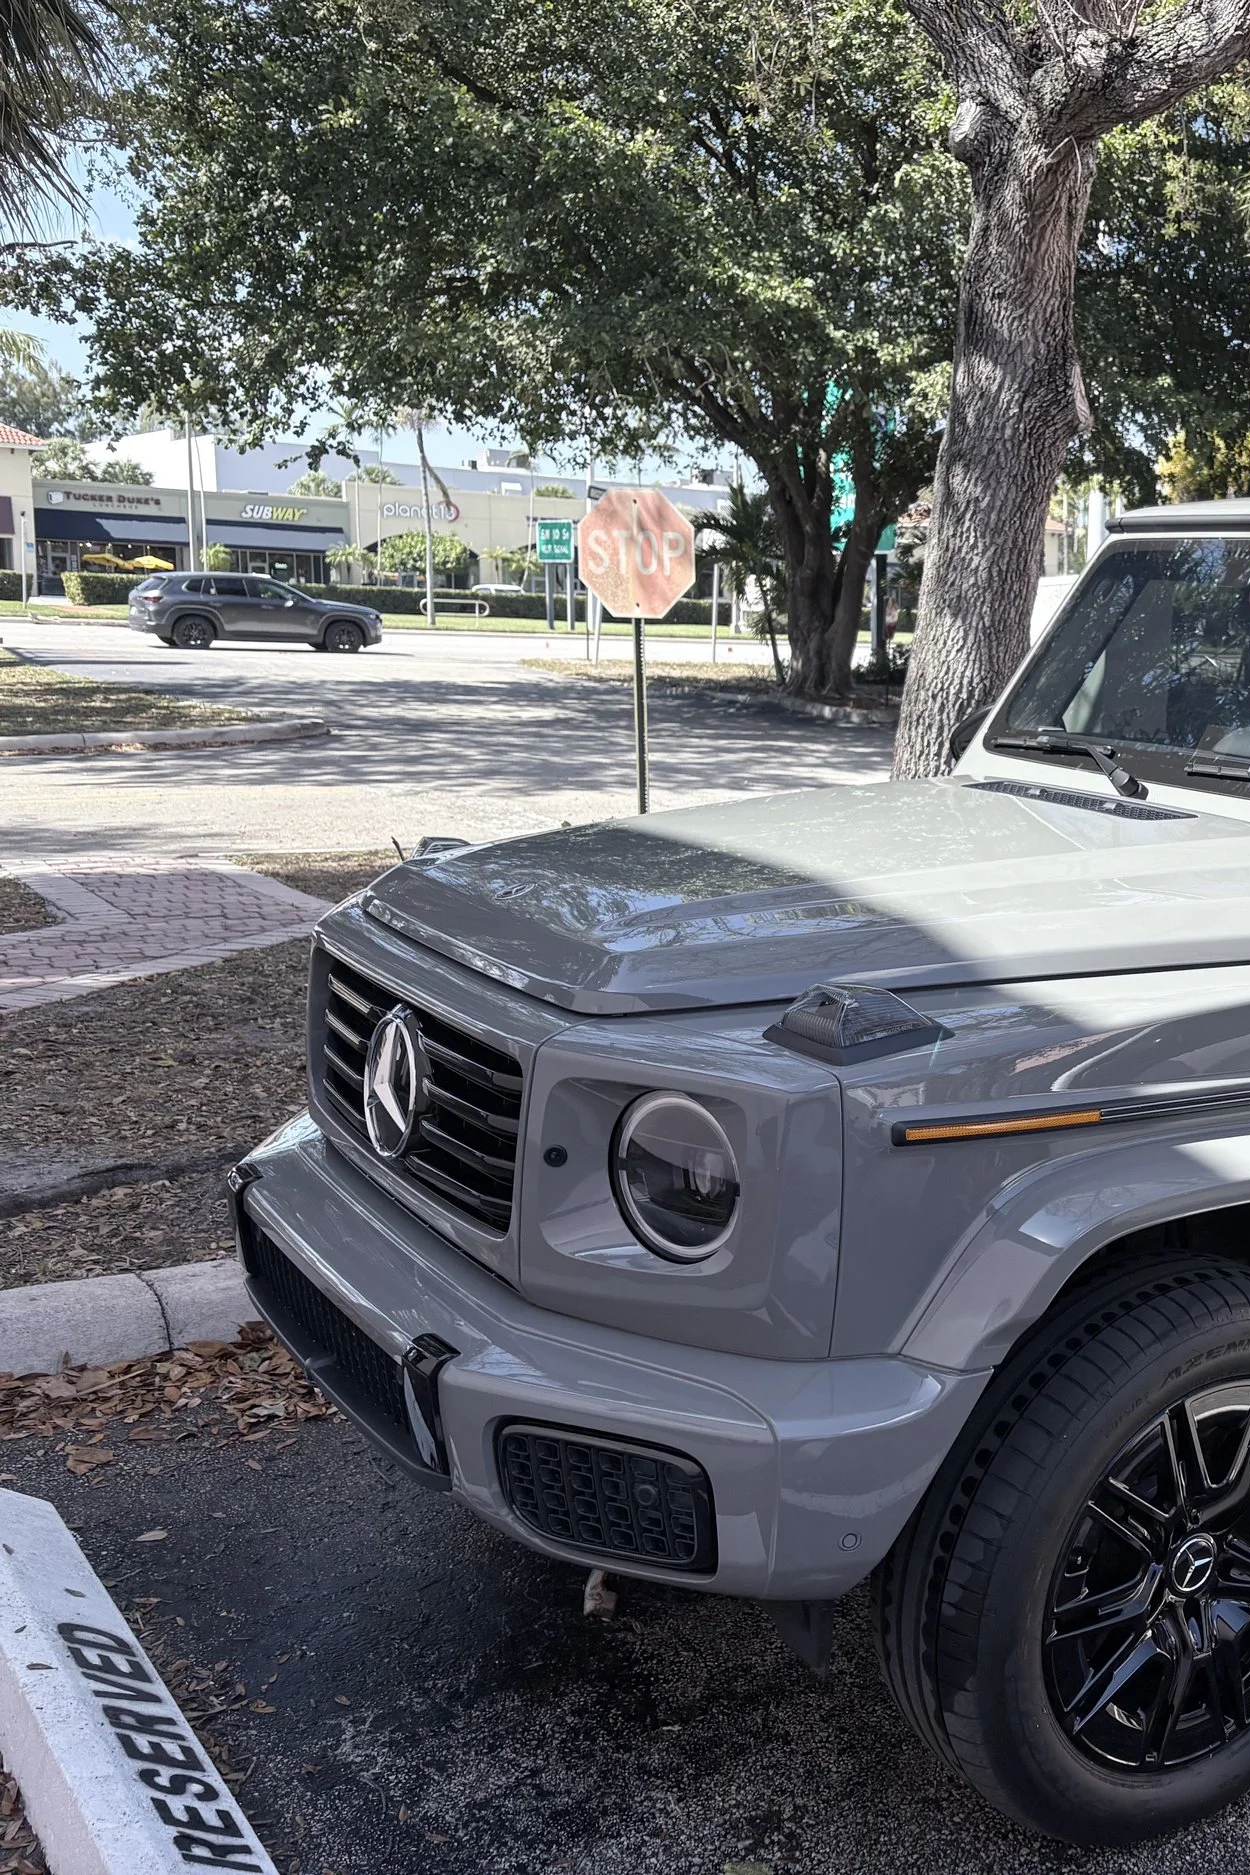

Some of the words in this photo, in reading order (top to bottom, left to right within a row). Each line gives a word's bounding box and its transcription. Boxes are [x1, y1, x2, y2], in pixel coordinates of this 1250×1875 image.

[241, 504, 307, 521] SUBWAY
[588, 530, 685, 576] STOP
[57, 1622, 263, 1873] RESERVED
